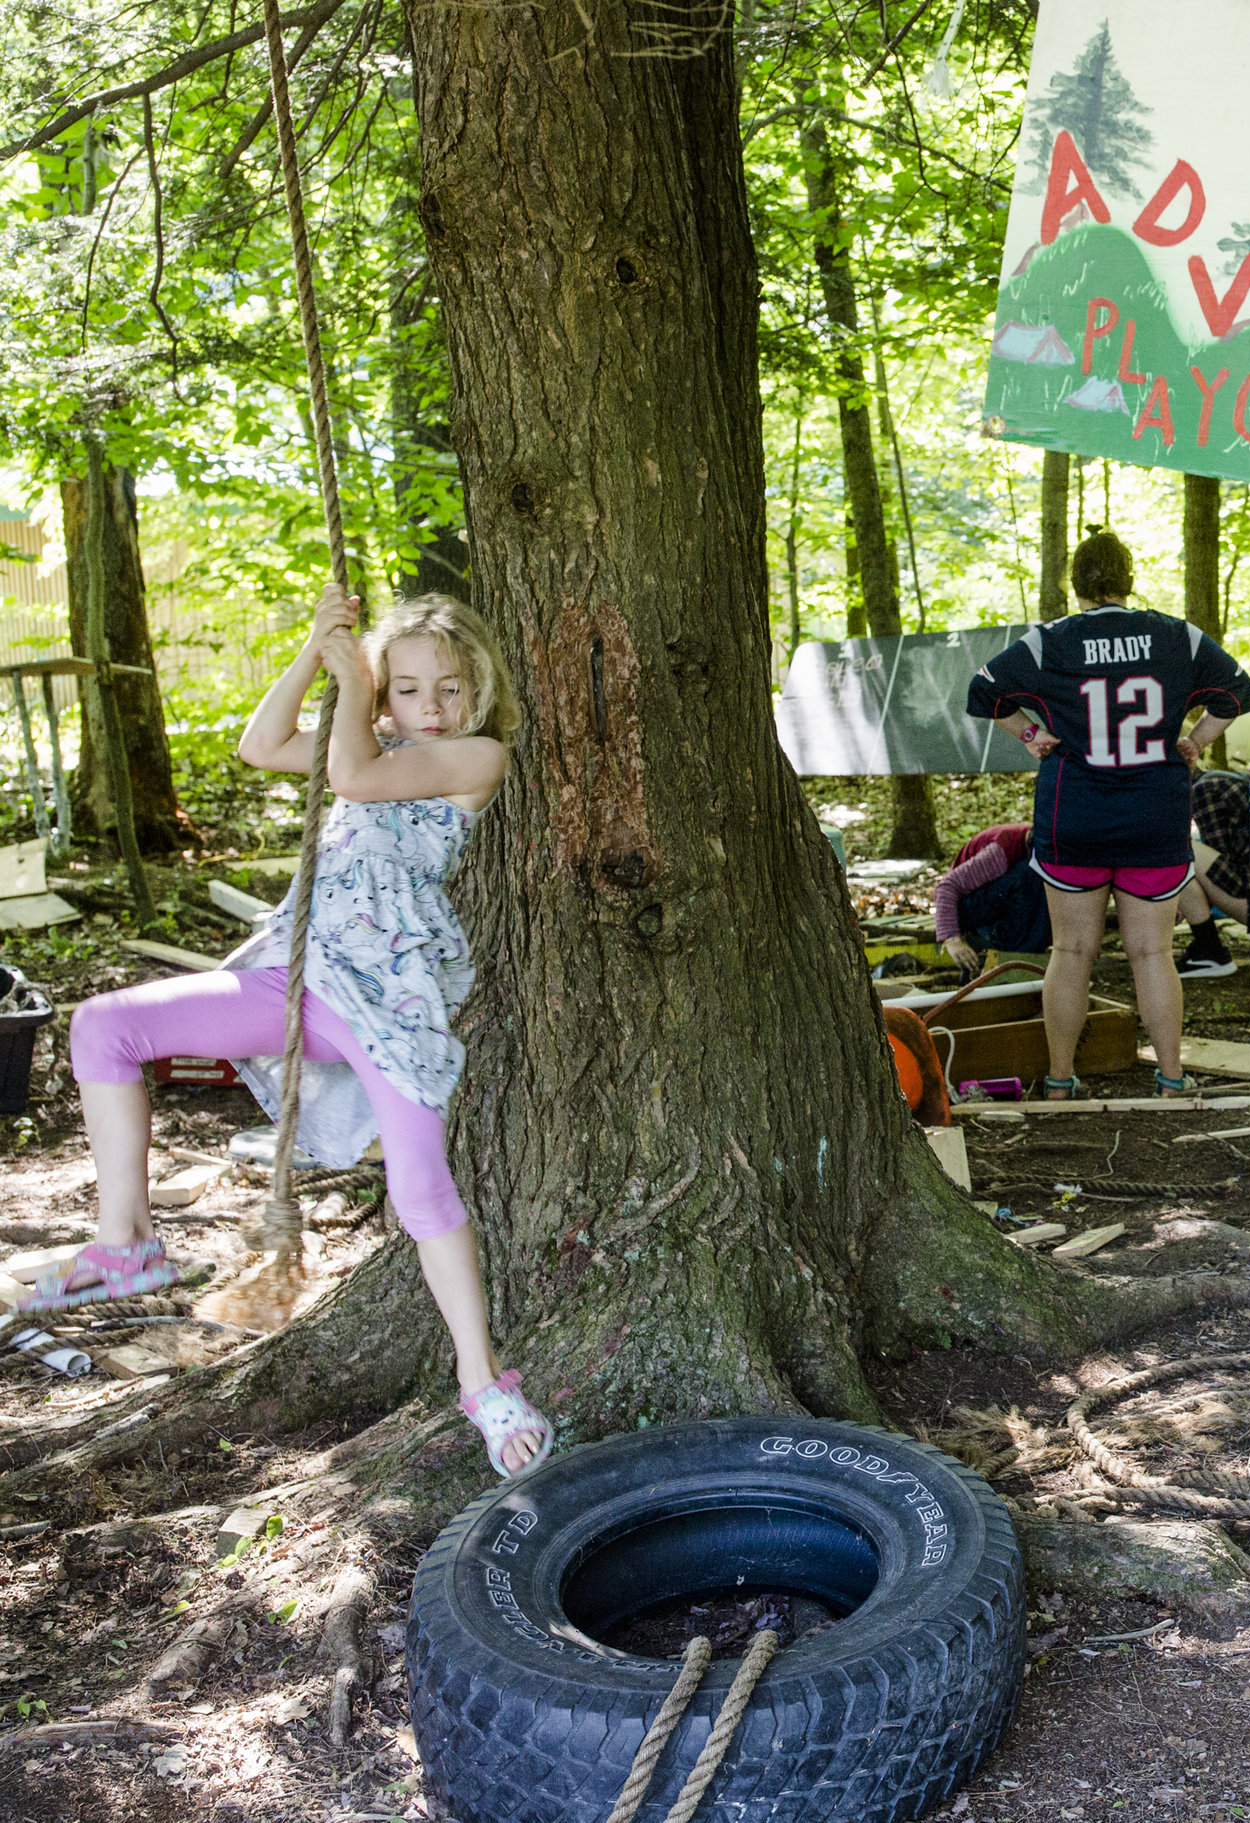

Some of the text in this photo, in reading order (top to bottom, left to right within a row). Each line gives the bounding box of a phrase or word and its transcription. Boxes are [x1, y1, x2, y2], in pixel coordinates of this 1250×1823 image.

[946, 632, 961, 648] 2
[1082, 634, 1152, 665] BRADY
[1079, 675, 1167, 767] 12
[760, 1436, 948, 1567] GOODYEAR
